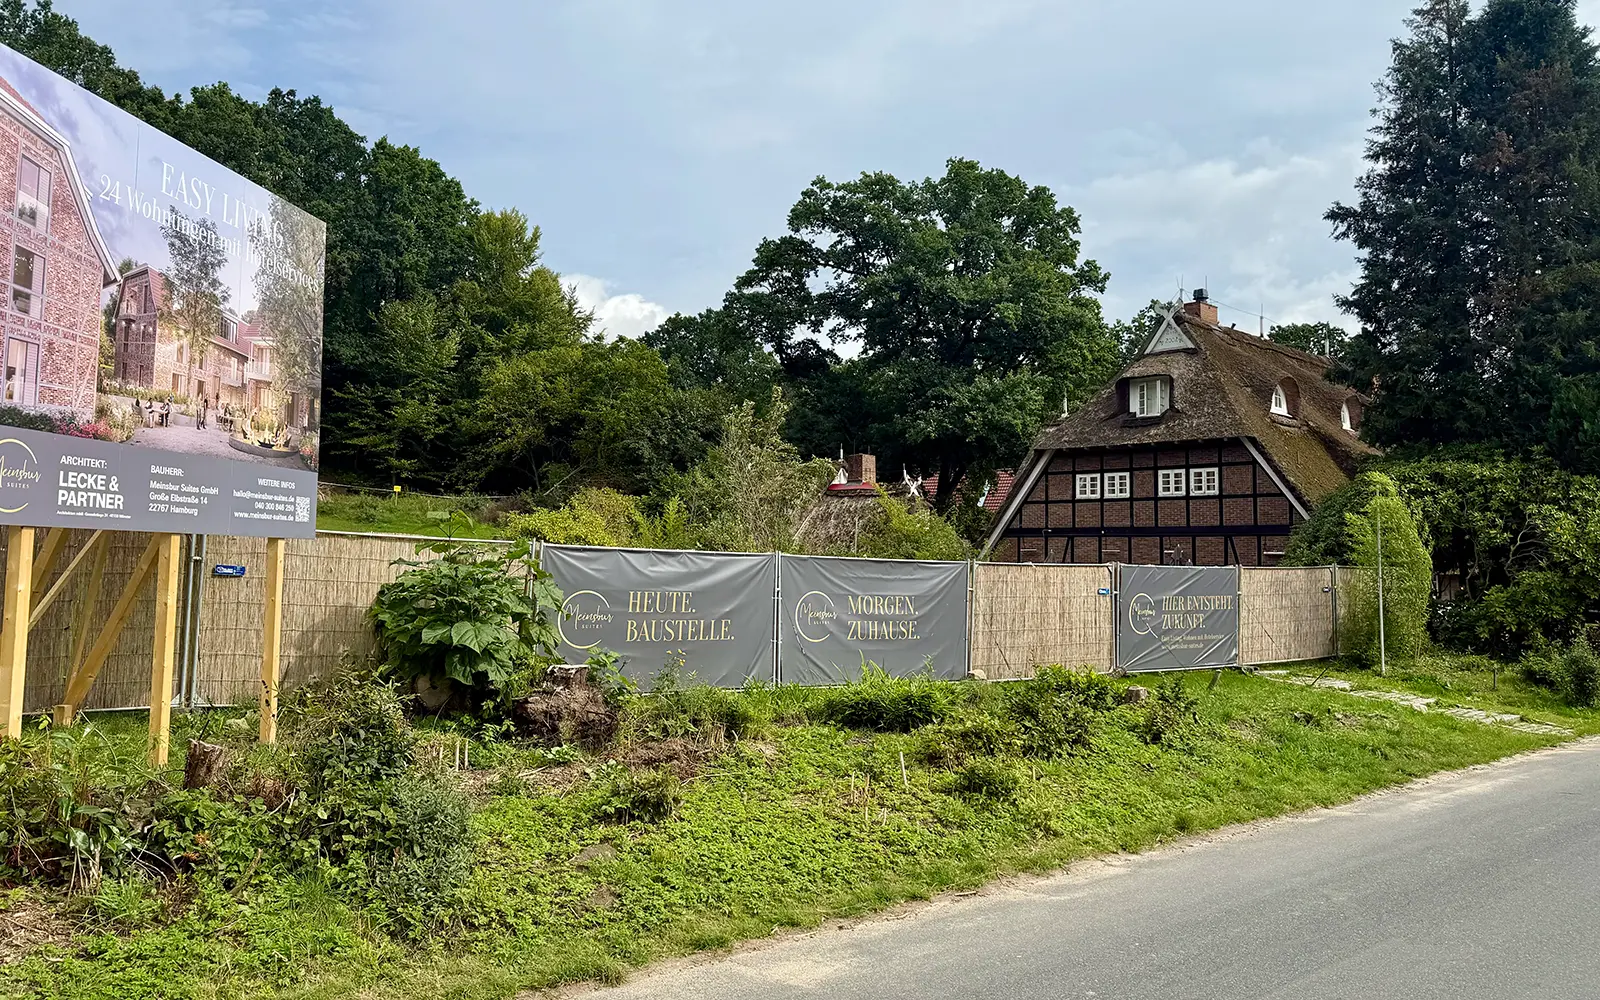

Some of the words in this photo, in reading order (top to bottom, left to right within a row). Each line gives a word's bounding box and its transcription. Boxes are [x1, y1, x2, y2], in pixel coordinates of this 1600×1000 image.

[161, 161, 216, 216] EASY
[222, 193, 284, 249] LIVING
[100, 174, 122, 206] 24
[126, 184, 220, 247] Wohnungen
[220, 235, 241, 258] mit
[246, 240, 318, 293] Hotelservices
[60, 455, 108, 469] ARCHITEKT:
[150, 465, 184, 477] BAUHERR:
[59, 470, 106, 490] LECKE
[109, 476, 119, 492] &
[150, 480, 180, 492] Meinsbur
[180, 484, 199, 494] Suites
[200, 486, 218, 495] GmbH
[258, 478, 280, 488] WEITERE
[281, 481, 295, 489] INFOS
[58, 490, 124, 510] PARTNER
[149, 492, 168, 502] Große
[170, 493, 198, 504] Elbstraße
[200, 496, 208, 505] 14
[148, 503, 169, 513] 22767
[170, 505, 198, 516] Hamburg
[628, 591, 696, 613] HEUTE.
[848, 595, 919, 615] MORGEN.
[1162, 596, 1185, 611] HIER
[1187, 595, 1234, 611] ENTSTEHT.
[564, 604, 614, 630] Meinsbur
[800, 603, 838, 625] Meinsbur
[1162, 614, 1206, 629] ZUKUNFT.
[626, 619, 735, 642] BAUSTELLE.
[847, 620, 920, 640] ZUHAUSE.
